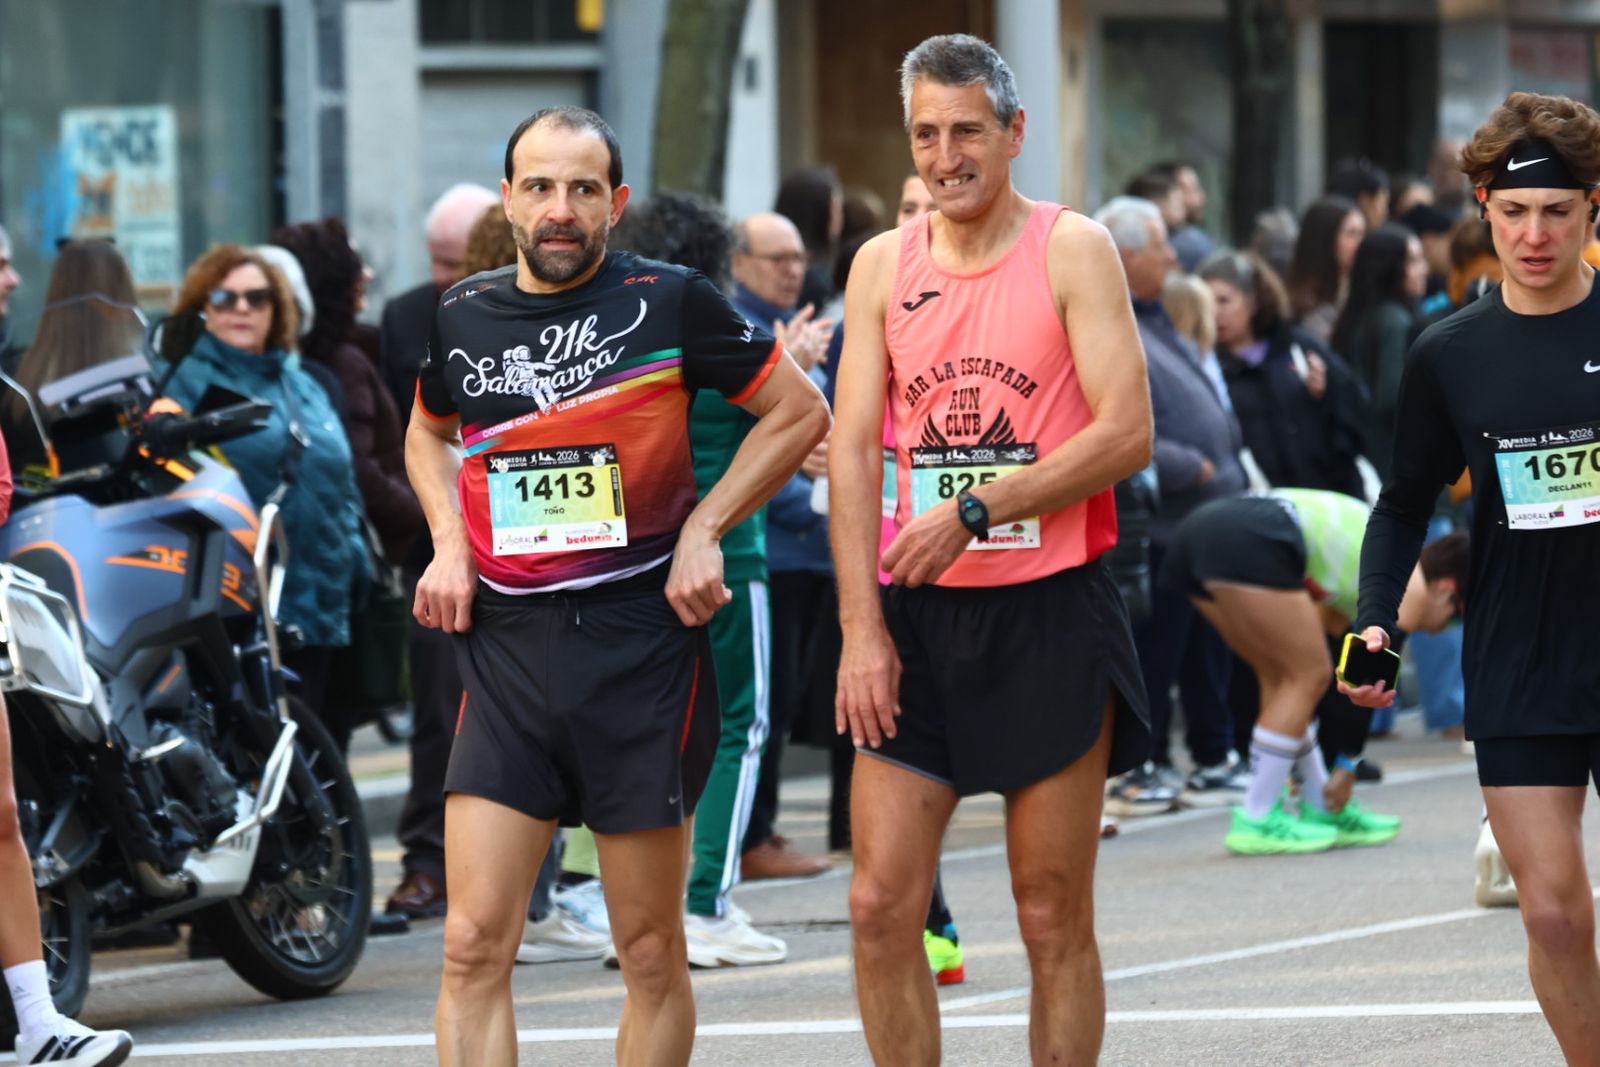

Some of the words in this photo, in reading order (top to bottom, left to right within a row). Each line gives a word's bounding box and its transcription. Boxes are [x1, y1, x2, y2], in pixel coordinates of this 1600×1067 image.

[540, 308, 626, 364] 21k
[449, 346, 625, 397] Salamanca
[931, 362, 957, 384] LA
[961, 357, 1039, 400] ESCAPADA
[482, 420, 514, 438] CORRE
[515, 412, 539, 426] CON
[557, 399, 577, 412] LUZ
[579, 386, 620, 405] PROPIA
[945, 413, 981, 437] CLUB
[1569, 428, 1594, 440] 2026
[1498, 438, 1513, 449] XIV
[556, 450, 580, 460] 2026
[970, 449, 996, 460] 2026
[515, 472, 595, 502] 1413
[1548, 481, 1592, 492] DECLAN11
[544, 507, 565, 515] TOÑO
